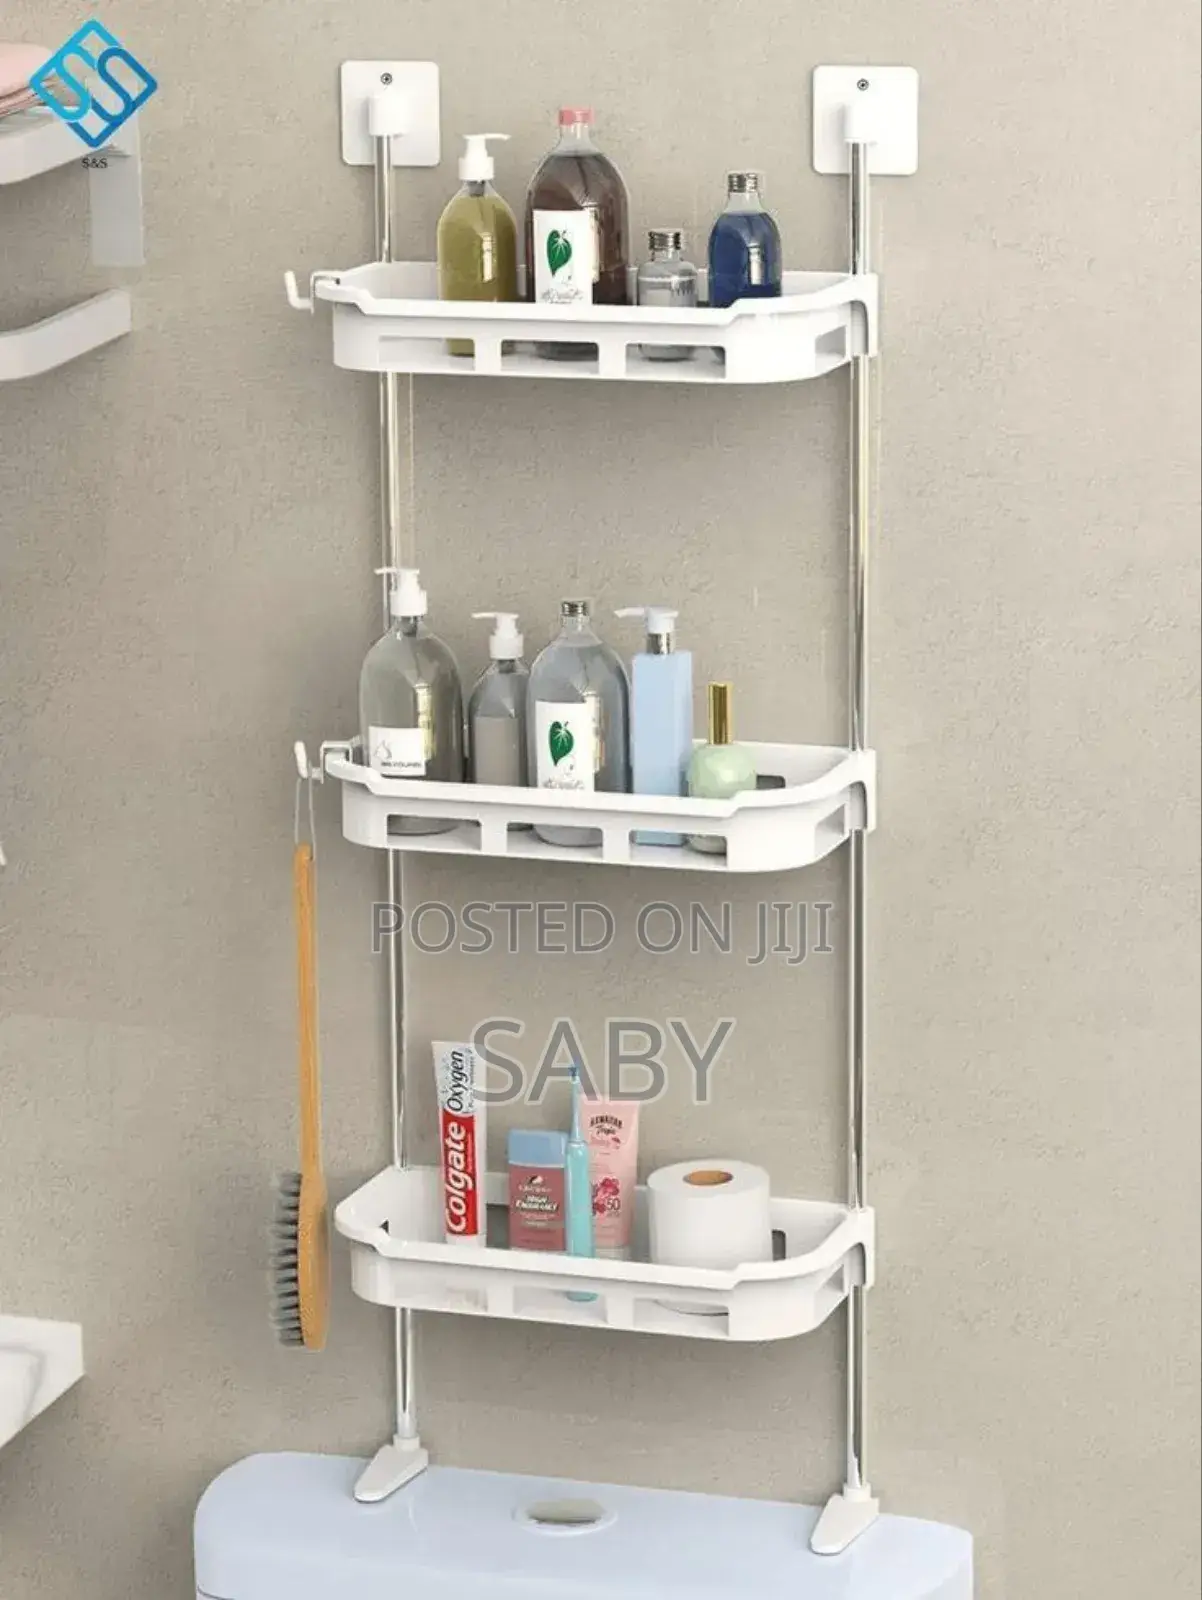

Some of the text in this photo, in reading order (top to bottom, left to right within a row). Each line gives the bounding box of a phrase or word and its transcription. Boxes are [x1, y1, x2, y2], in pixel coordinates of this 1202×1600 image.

[446, 1050, 469, 1112] Oxygen
[445, 1121, 473, 1233] Colgate
[606, 1198, 621, 1211] 50
